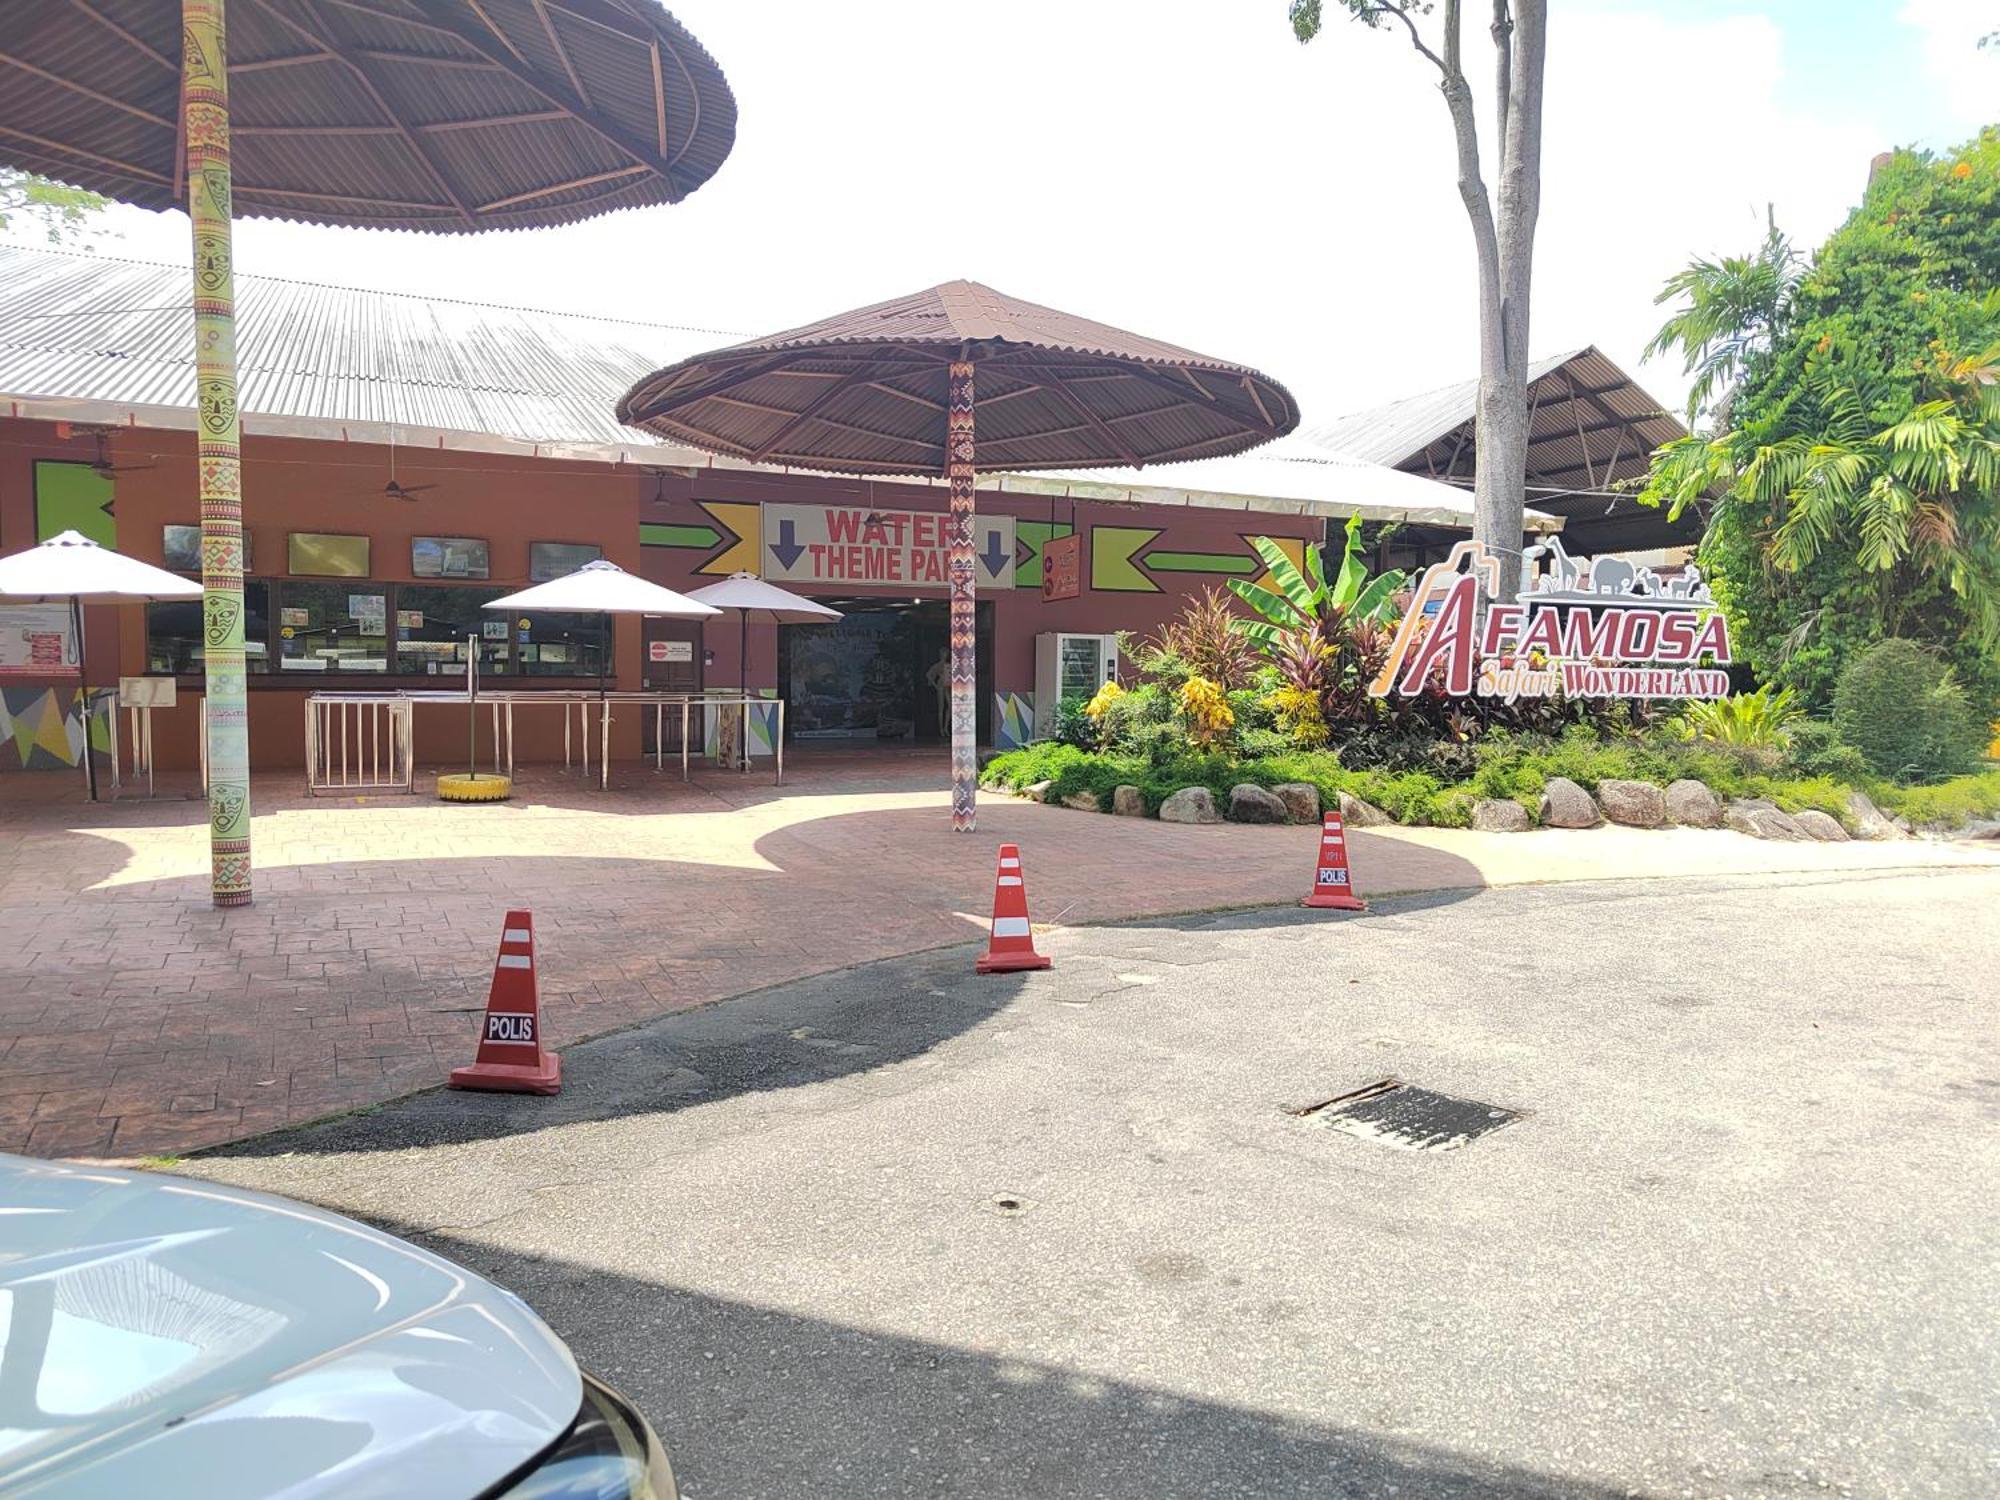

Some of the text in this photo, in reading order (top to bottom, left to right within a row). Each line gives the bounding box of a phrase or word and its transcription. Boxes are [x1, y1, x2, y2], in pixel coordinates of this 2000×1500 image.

[825, 509, 953, 547] WATER
[808, 544, 960, 582] THEME PA
[1481, 605, 1731, 662] FAMOSA
[1477, 659, 1730, 704] Safari WONDERLAND
[1320, 869, 1346, 883] POLIS
[488, 1016, 532, 1040] POLIS
